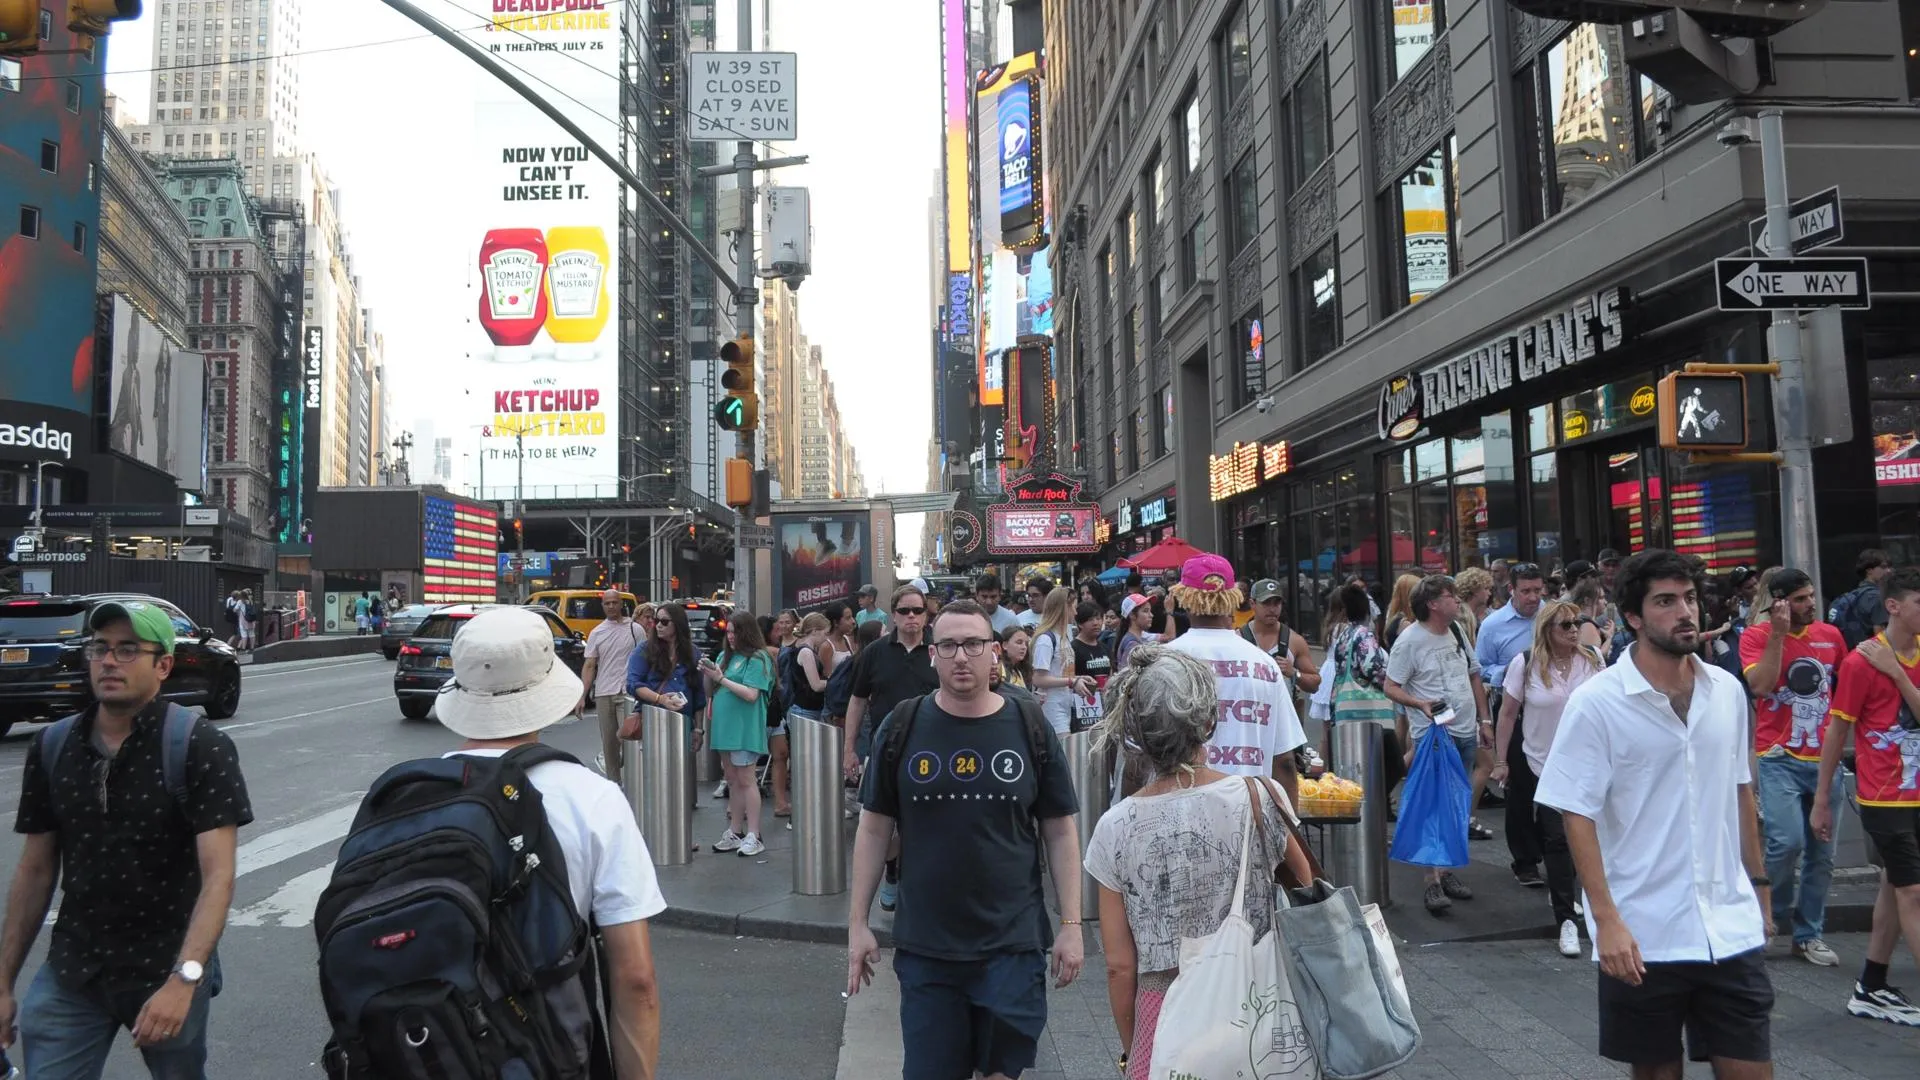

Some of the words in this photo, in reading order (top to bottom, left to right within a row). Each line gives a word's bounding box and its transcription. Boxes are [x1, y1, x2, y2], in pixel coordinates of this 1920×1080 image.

[493, 0, 605, 12] DEADPOOL
[492, 12, 611, 31] WOLVERINE
[490, 44, 500, 53] IN
[506, 43, 557, 52] THEATERS
[562, 41, 586, 51] JULY
[590, 41, 604, 50] 26
[706, 61, 720, 74] W
[728, 61, 751, 74] 39
[759, 61, 781, 74] ST
[706, 80, 781, 93] CLOSED
[699, 99, 723, 112] AT
[731, 99, 742, 112] 9
[750, 99, 788, 112] AVE
[698, 118, 735, 131] SAT
[750, 118, 789, 131] SUN
[503, 148, 545, 163] NOW
[551, 146, 589, 162] YOU
[1003, 157, 1028, 175] TACO
[520, 166, 573, 181] CAN'T
[1005, 168, 1028, 189] BELL
[503, 185, 562, 201] UNSEE
[568, 184, 589, 200] IT.
[1799, 208, 1826, 236] WAY
[500, 256, 530, 266] HEINZ
[561, 257, 590, 267] HEINZ
[495, 270, 533, 280] TOMATO
[496, 279, 532, 287] KETCHUP
[556, 279, 594, 288] MUSTARD
[1742, 275, 1784, 293] ONE
[1804, 274, 1847, 293] WAY
[1422, 337, 1512, 418] RAISING
[1517, 287, 1622, 382] CANE'S
[533, 377, 557, 385] HEINZ
[494, 388, 600, 413] KETCHUP
[1378, 371, 1417, 440] Cane's
[482, 425, 492, 437] &
[493, 411, 606, 437] MUSTARD
[490, 450, 498, 460] IT
[503, 449, 524, 460] HAS
[529, 448, 542, 459] TO
[546, 448, 557, 459] BE
[562, 446, 597, 458] HEINZ
[1018, 489, 1043, 500] Hard
[1044, 487, 1068, 500] Rock
[1006, 518, 1050, 528] BACKPACK
[1011, 527, 1029, 537] FOR
[37, 553, 87, 561] HOTDOGS
[1081, 707, 1098, 717] NY
[919, 759, 929, 775] 8
[956, 757, 976, 774] 24
[1003, 758, 1013, 774] 2
